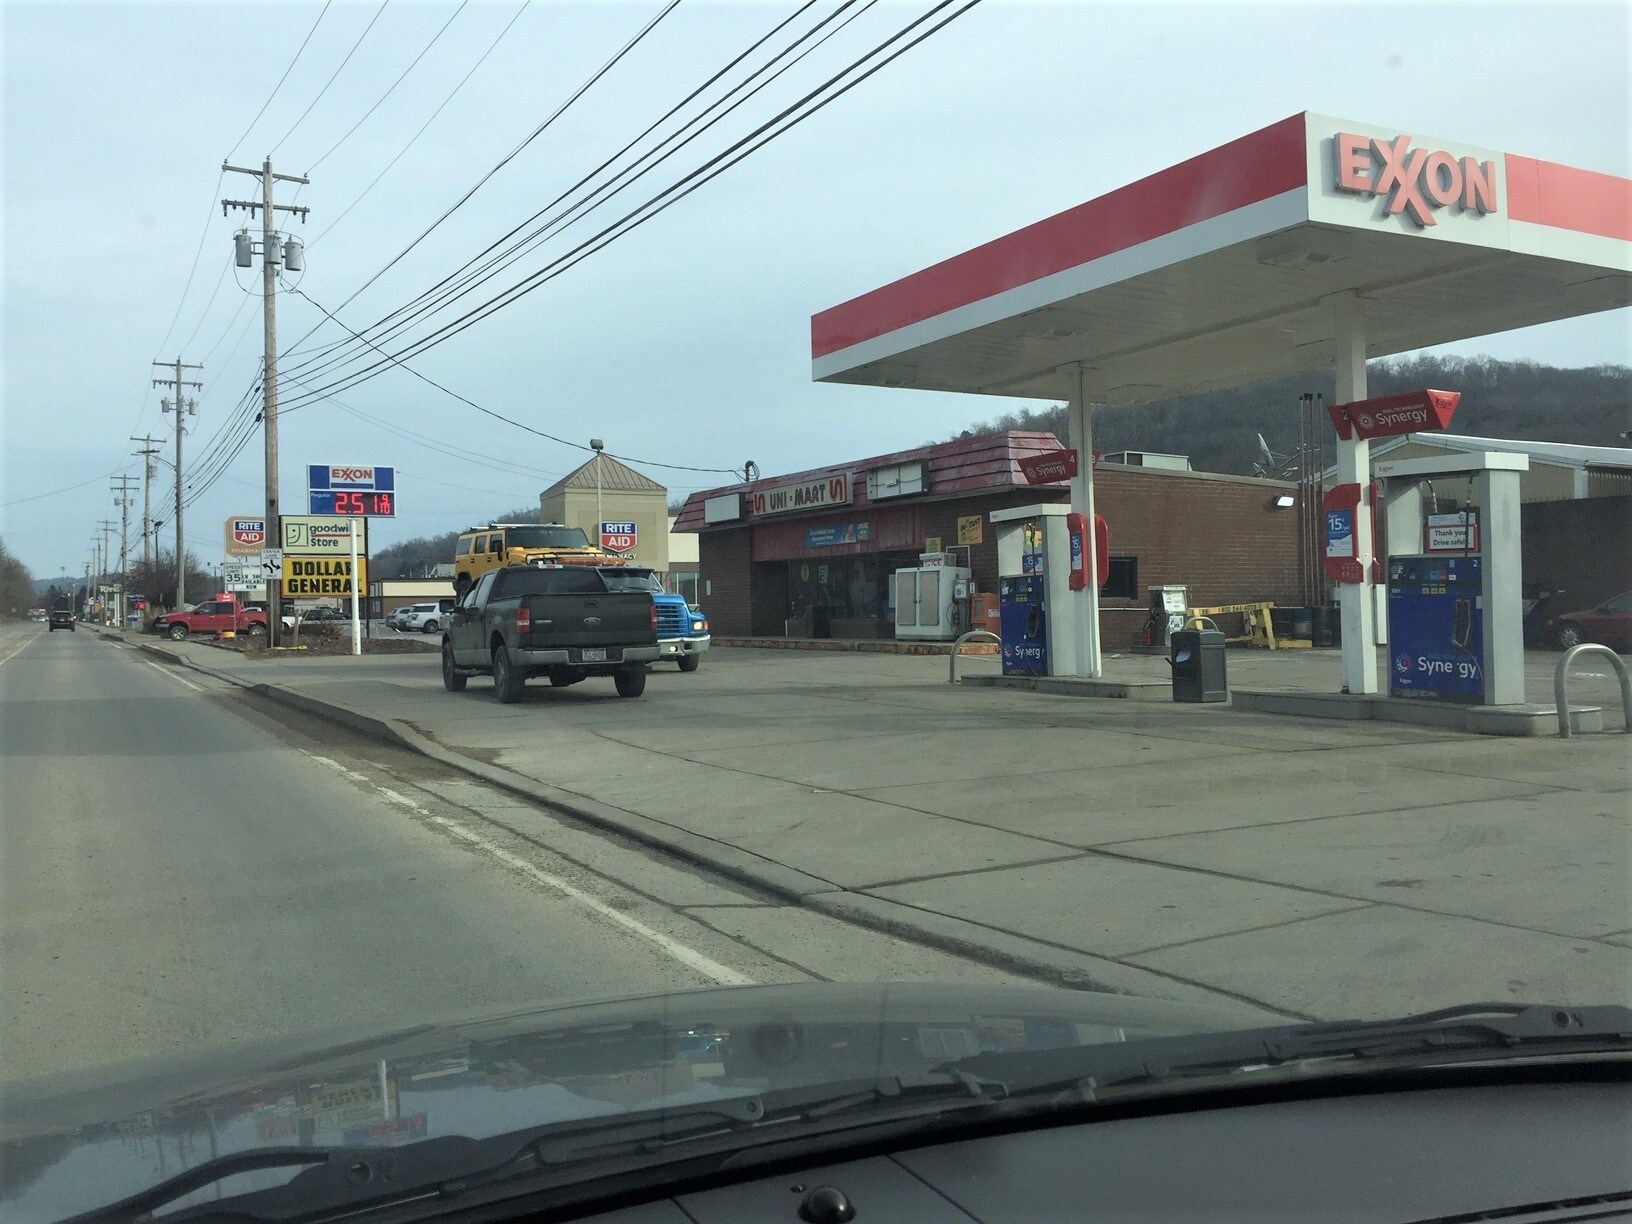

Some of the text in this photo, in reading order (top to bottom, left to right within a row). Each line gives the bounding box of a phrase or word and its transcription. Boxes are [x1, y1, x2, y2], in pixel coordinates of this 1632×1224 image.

[1334, 132, 1497, 226] EXXON
[1375, 409, 1427, 426] Synergy
[1069, 455, 1075, 463] 4
[331, 468, 373, 482] EXXON
[1036, 464, 1066, 477] Synergy
[238, 522, 260, 530] RITE
[606, 523, 632, 533] RITE
[240, 533, 260, 541] AID
[1434, 529, 1453, 537] Thank
[310, 538, 339, 547] Store
[608, 536, 631, 547] AID
[1433, 538, 1449, 546] Drive
[1473, 559, 1478, 567] 2
[226, 573, 241, 582] 35
[1418, 656, 1477, 678] Synegy
